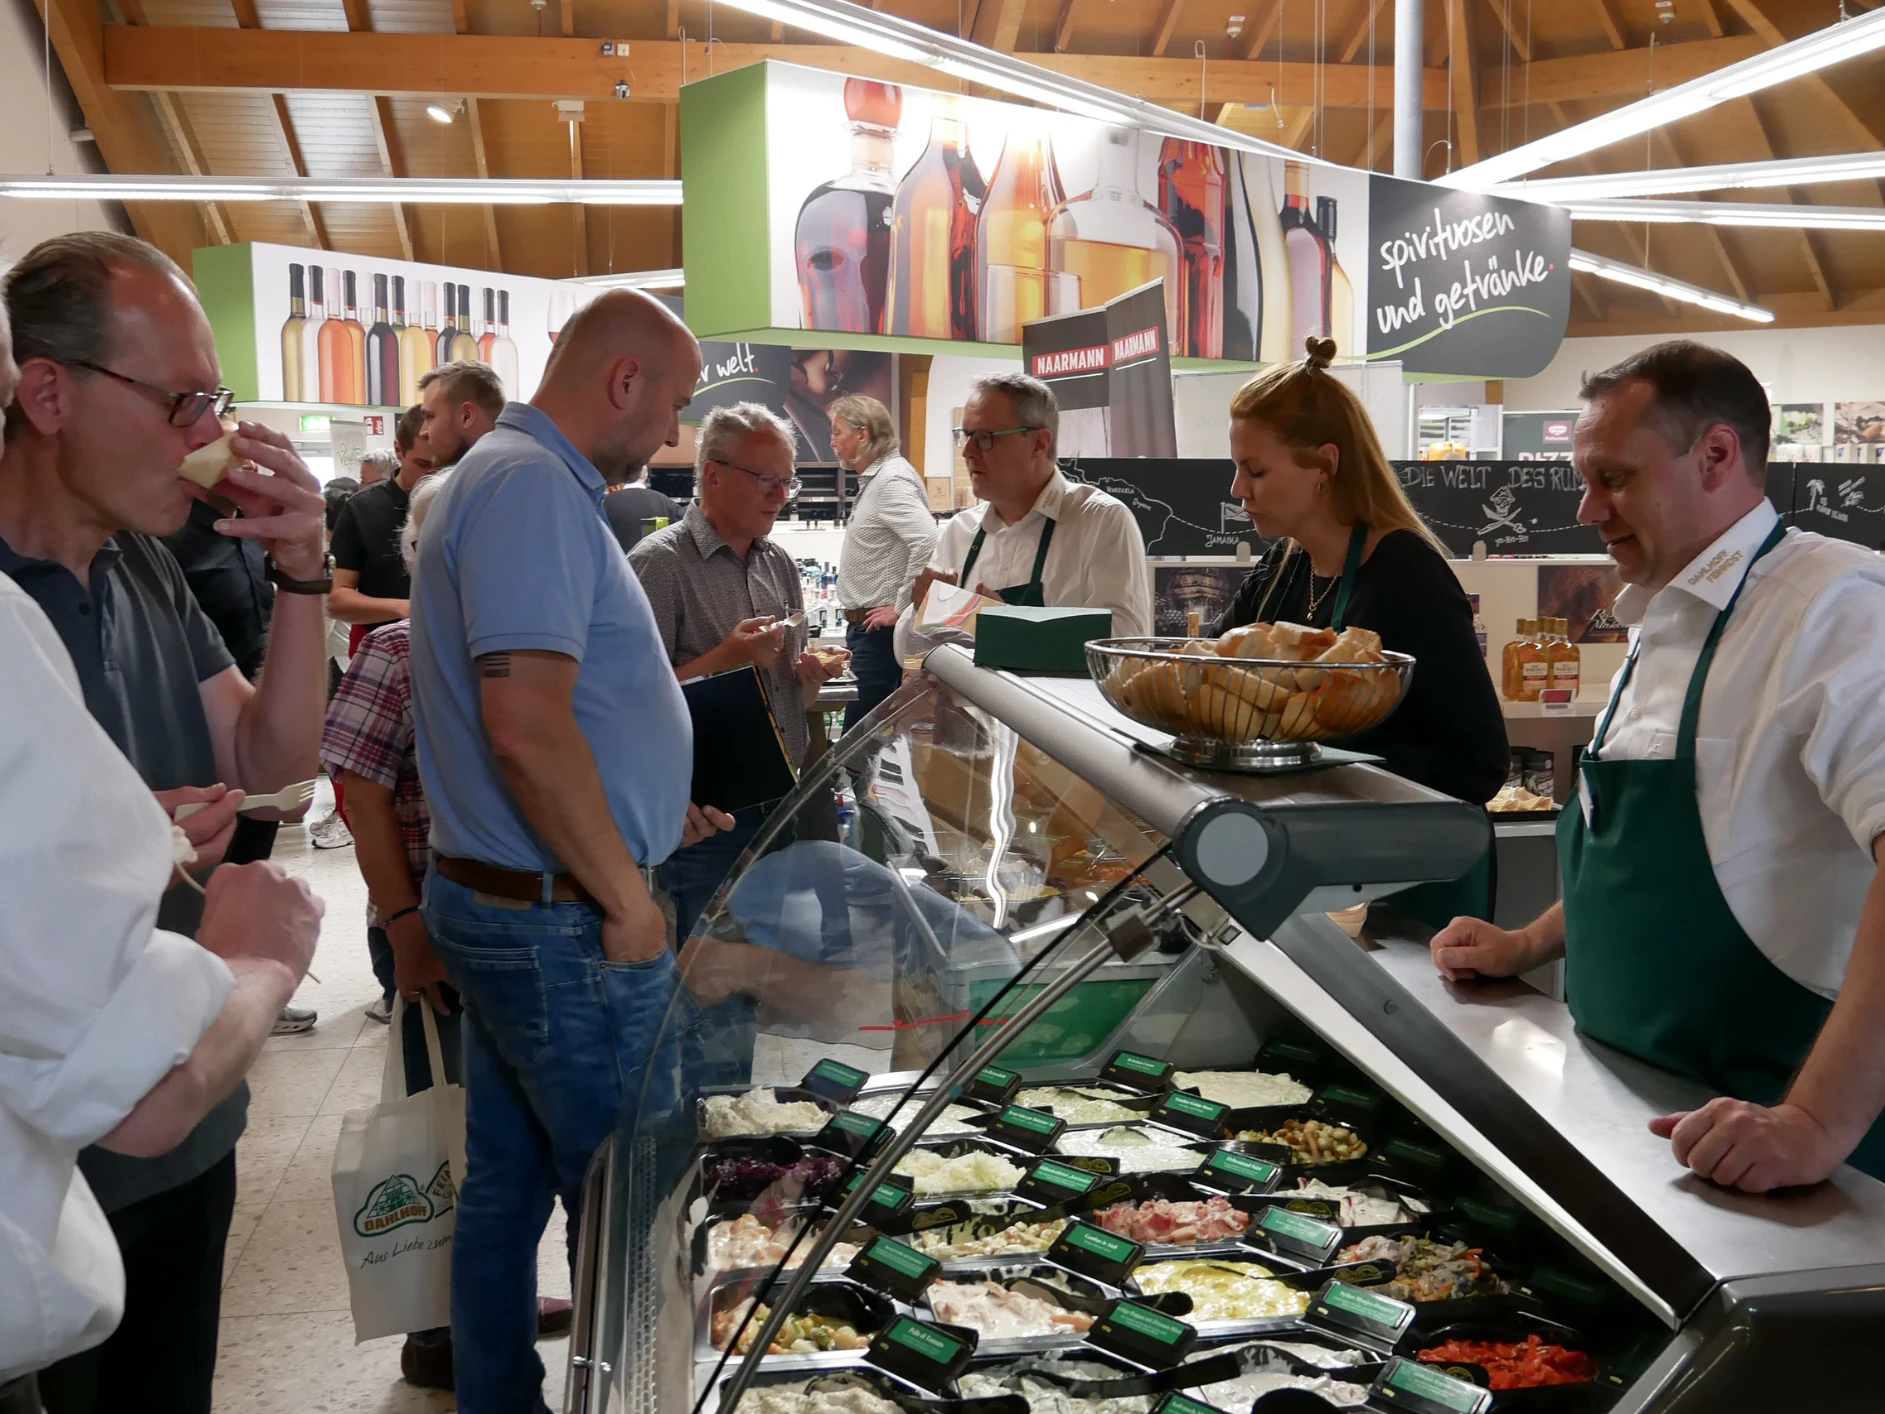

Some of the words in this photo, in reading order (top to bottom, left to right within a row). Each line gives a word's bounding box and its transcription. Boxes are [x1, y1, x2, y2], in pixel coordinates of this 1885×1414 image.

[1380, 207, 1515, 288] spirituosen
[1376, 277, 1425, 333] und
[1037, 347, 1105, 375] NAARMANN
[1113, 329, 1156, 361] NAARMANN
[1402, 466, 1435, 488] DIE
[1440, 465, 1491, 489] WELT
[1508, 466, 1545, 488] DES
[364, 1206, 427, 1232] DAHLHOFF
[361, 1250, 389, 1269] Aus
[391, 1236, 424, 1258] Liebe
